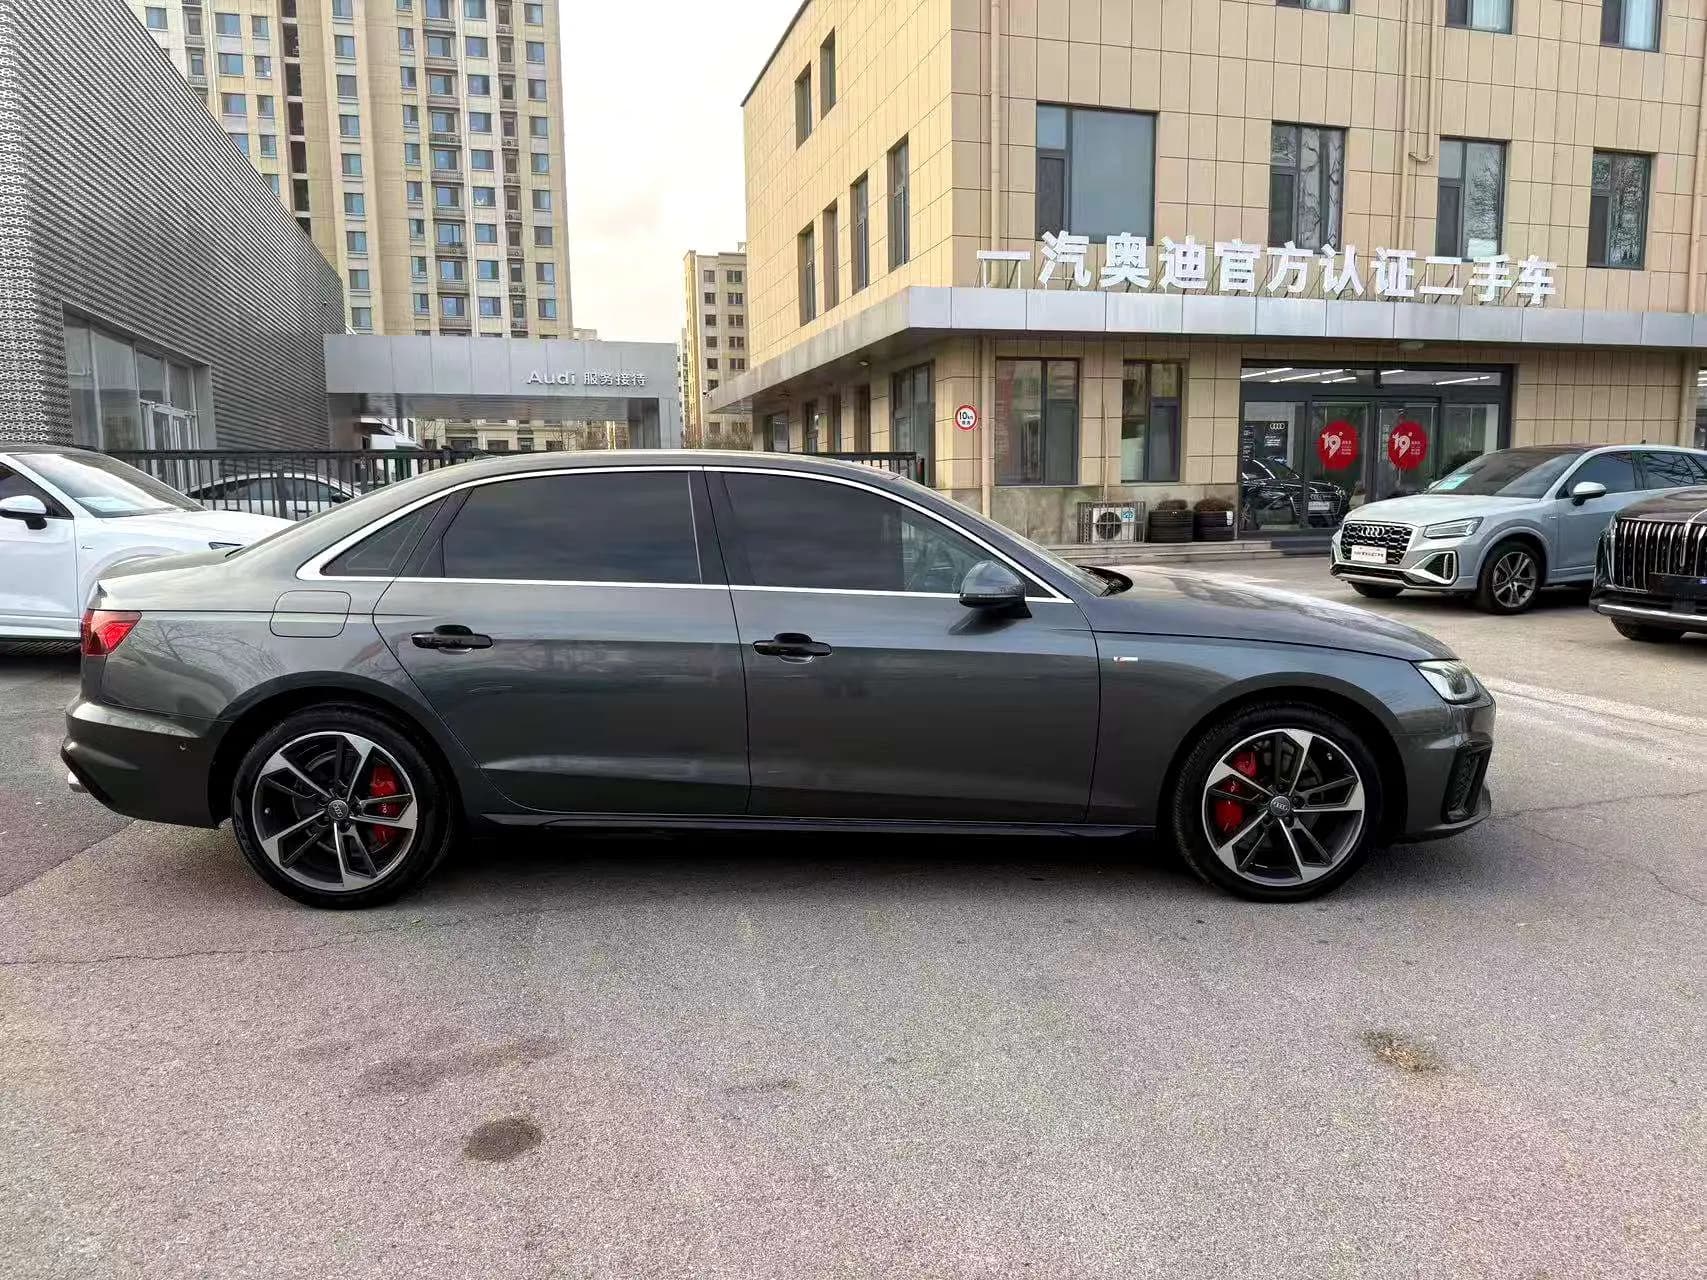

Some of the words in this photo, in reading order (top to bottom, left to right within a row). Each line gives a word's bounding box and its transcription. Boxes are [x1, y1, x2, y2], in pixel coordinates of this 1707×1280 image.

[976, 230, 1558, 306] 一汽奥迪官方认证二手车
[527, 370, 576, 385] Audi
[583, 371, 648, 386] 服务接待
